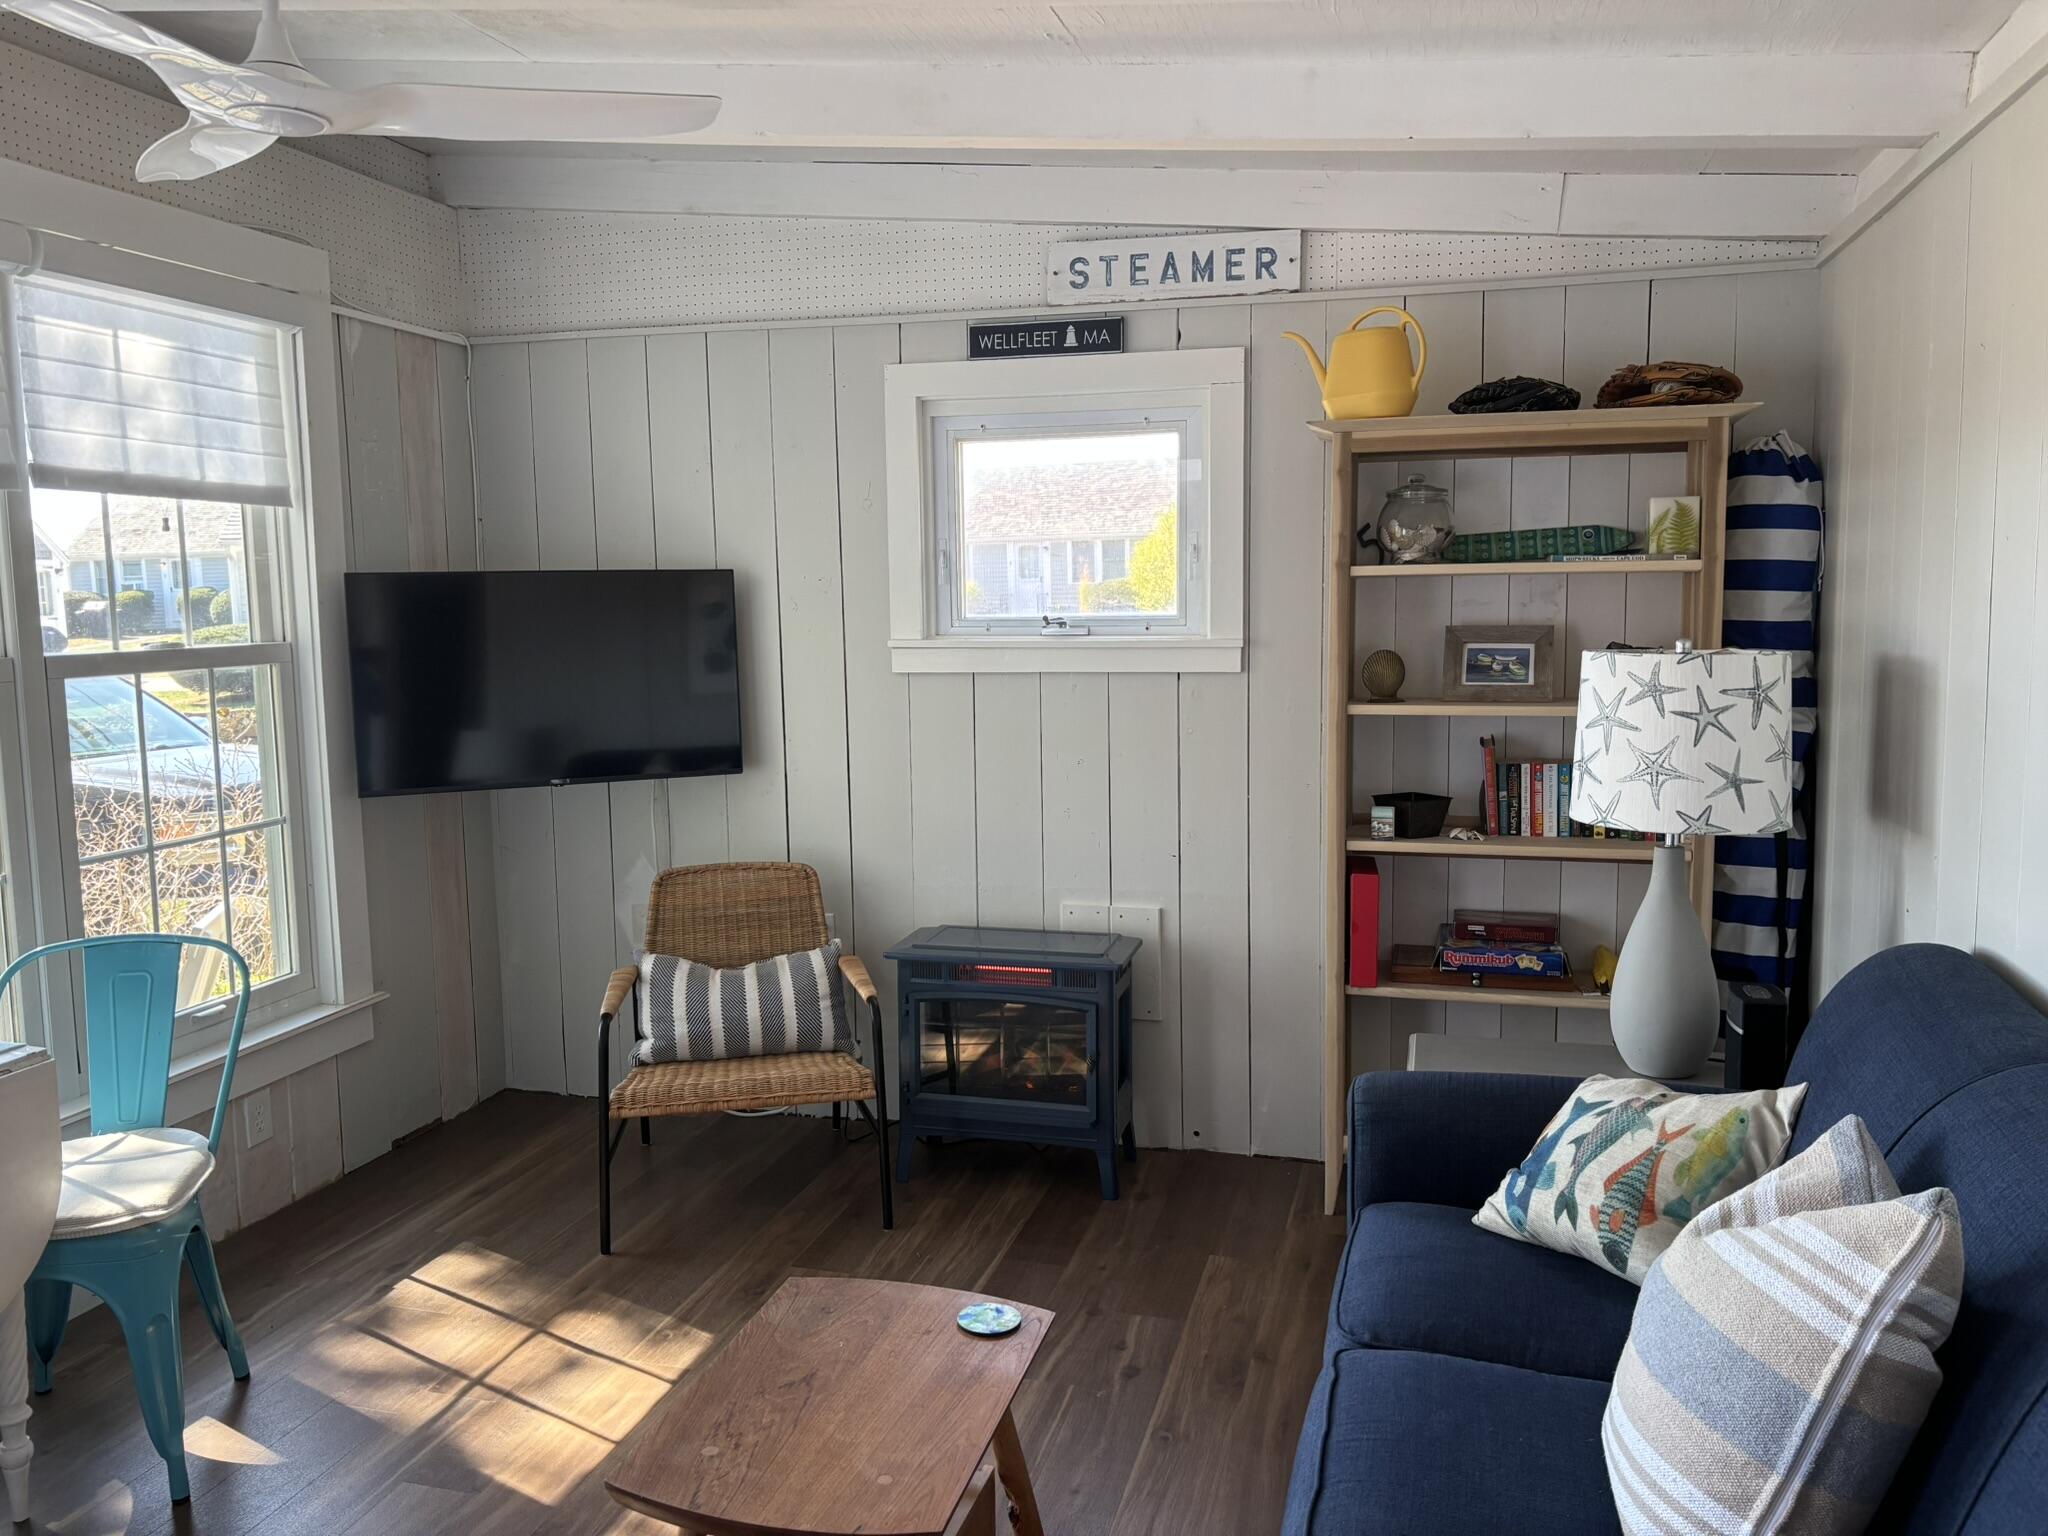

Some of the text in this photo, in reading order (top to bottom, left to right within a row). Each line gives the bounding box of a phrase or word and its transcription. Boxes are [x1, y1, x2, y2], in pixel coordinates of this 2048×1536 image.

[1068, 246, 1279, 290] STEAMER
[978, 328, 1111, 350] WELLFLEET MA
[1443, 950, 1515, 967] Rummikub
